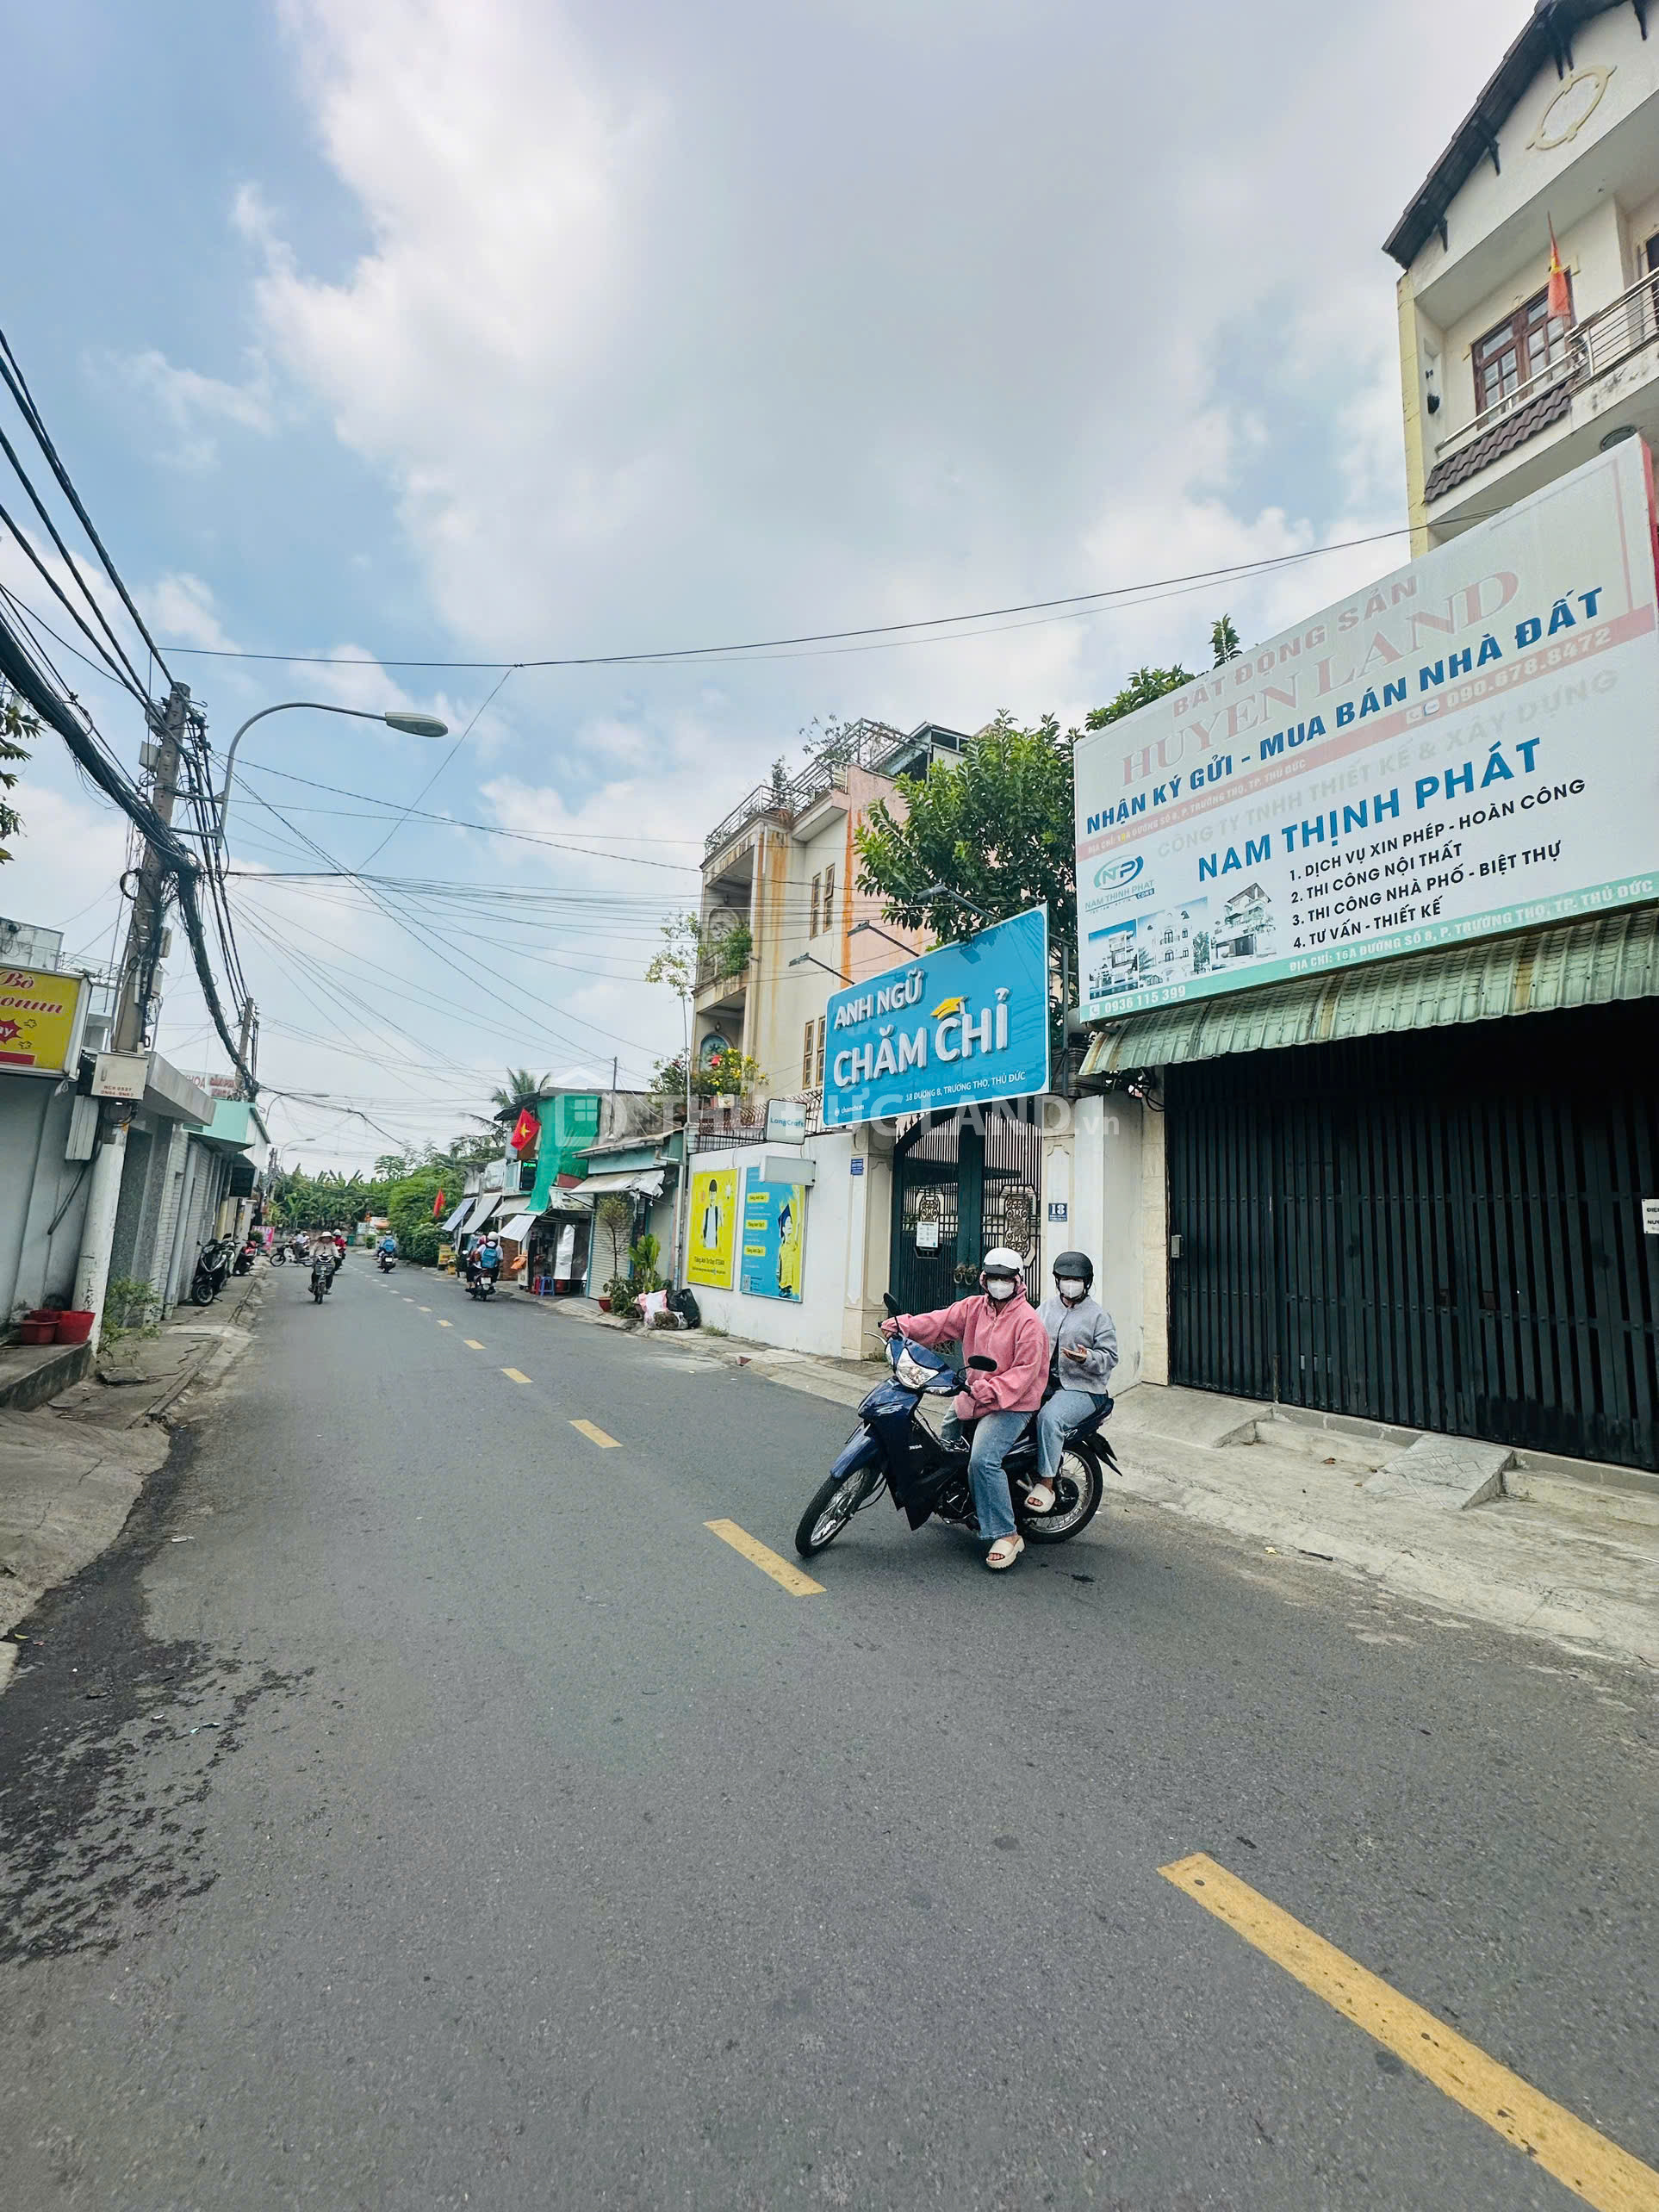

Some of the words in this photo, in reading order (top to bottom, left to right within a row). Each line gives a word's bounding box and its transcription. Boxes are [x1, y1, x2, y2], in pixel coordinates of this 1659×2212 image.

[1314, 571, 1519, 699] LAND
[1087, 793, 1146, 834] NHẬN
[1153, 774, 1183, 806] KÝ
[1190, 754, 1233, 791] GỬI
[1260, 715, 1327, 761] MUA
[1336, 676, 1407, 728] BÁN
[1420, 632, 1503, 692] NHÀ
[1514, 587, 1602, 649] ĐẤT
[1198, 834, 1271, 882] NAM
[1281, 788, 1400, 853] THỊNH
[1415, 736, 1541, 810] PHÁT
[1289, 869, 1301, 881] 1.
[1305, 855, 1341, 877] DỊCH
[1345, 848, 1365, 864] VỤ
[1370, 837, 1398, 857] XIN
[1403, 823, 1445, 847] PHÉP
[1459, 801, 1514, 830] HOÀN
[1520, 779, 1585, 810] CÔNG
[1085, 897, 1104, 910] NAM
[1291, 892, 1302, 904] 2.
[1307, 882, 1328, 899] THI
[1333, 868, 1379, 892] CÔNG
[1385, 856, 1414, 877] NỘI
[1420, 840, 1462, 867] THẤT
[1292, 914, 1304, 926] 3.
[1308, 905, 1330, 922] THI
[1334, 892, 1382, 915] CÔNG
[1386, 879, 1422, 902] NHÀ
[1426, 864, 1464, 891] PHỐ
[1479, 854, 1517, 877] BIỆT
[1522, 840, 1561, 865] THỰ
[1293, 937, 1306, 948] 4.
[1309, 929, 1327, 945] TƯ
[1330, 919, 1361, 940] VẤN
[1373, 904, 1416, 929] THIẾT
[1420, 896, 1443, 918] KẾ
[1440, 926, 1452, 938] P.
[1555, 897, 1578, 913] TP.
[0, 970, 34, 989] Bò
[834, 994, 874, 1029] ANH
[877, 967, 925, 1016] NGỮ
[1104, 997, 1134, 1014] 0936
[1137, 991, 1159, 1007] 115
[1161, 985, 1186, 1000] 399
[834, 1024, 928, 1087] CHĂM
[935, 987, 1011, 1062] CHỈ
[1051, 1203, 1065, 1215] 18
